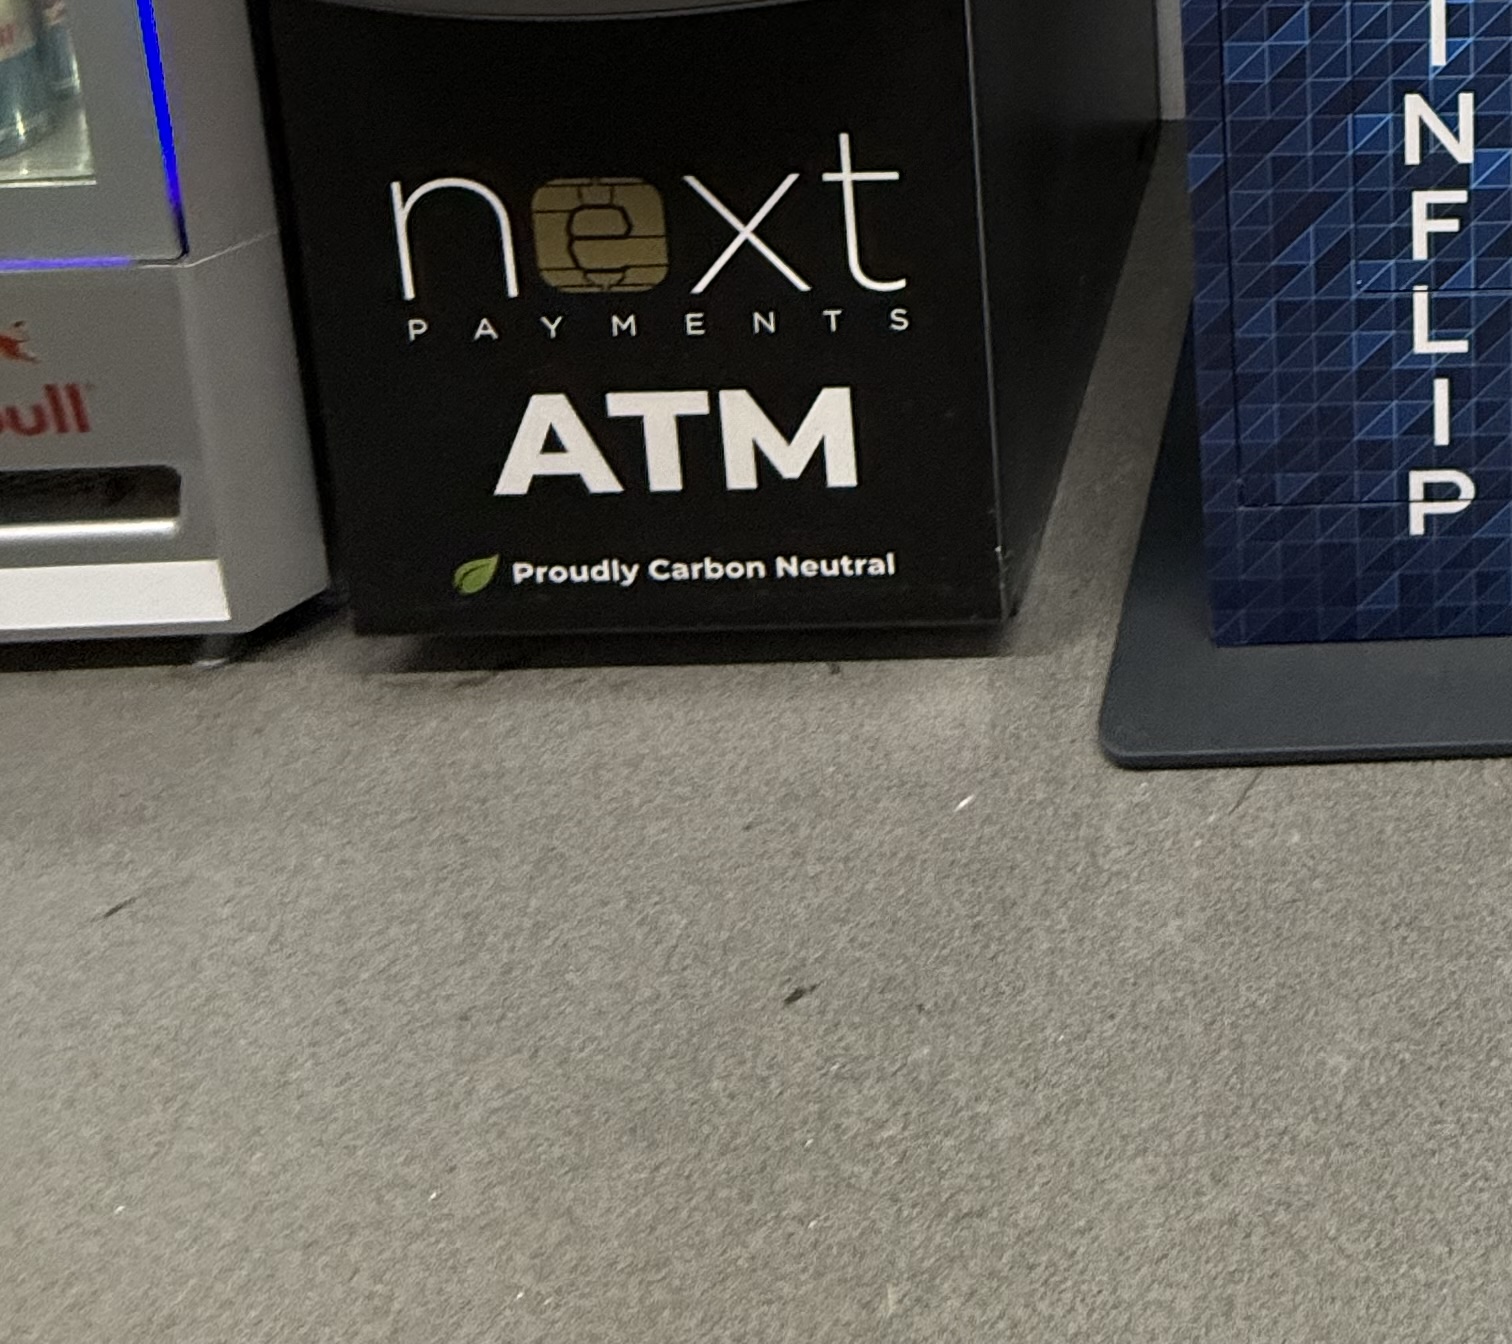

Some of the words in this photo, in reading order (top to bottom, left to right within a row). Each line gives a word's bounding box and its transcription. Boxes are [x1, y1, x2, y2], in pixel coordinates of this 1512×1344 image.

[390, 132, 907, 300] next
[408, 307, 910, 341] PAYMENTS
[0, 383, 91, 437] ull
[494, 386, 858, 496] ATM
[512, 558, 639, 587] Proudly
[648, 555, 766, 582] Carbon
[775, 552, 895, 578] Neutral
